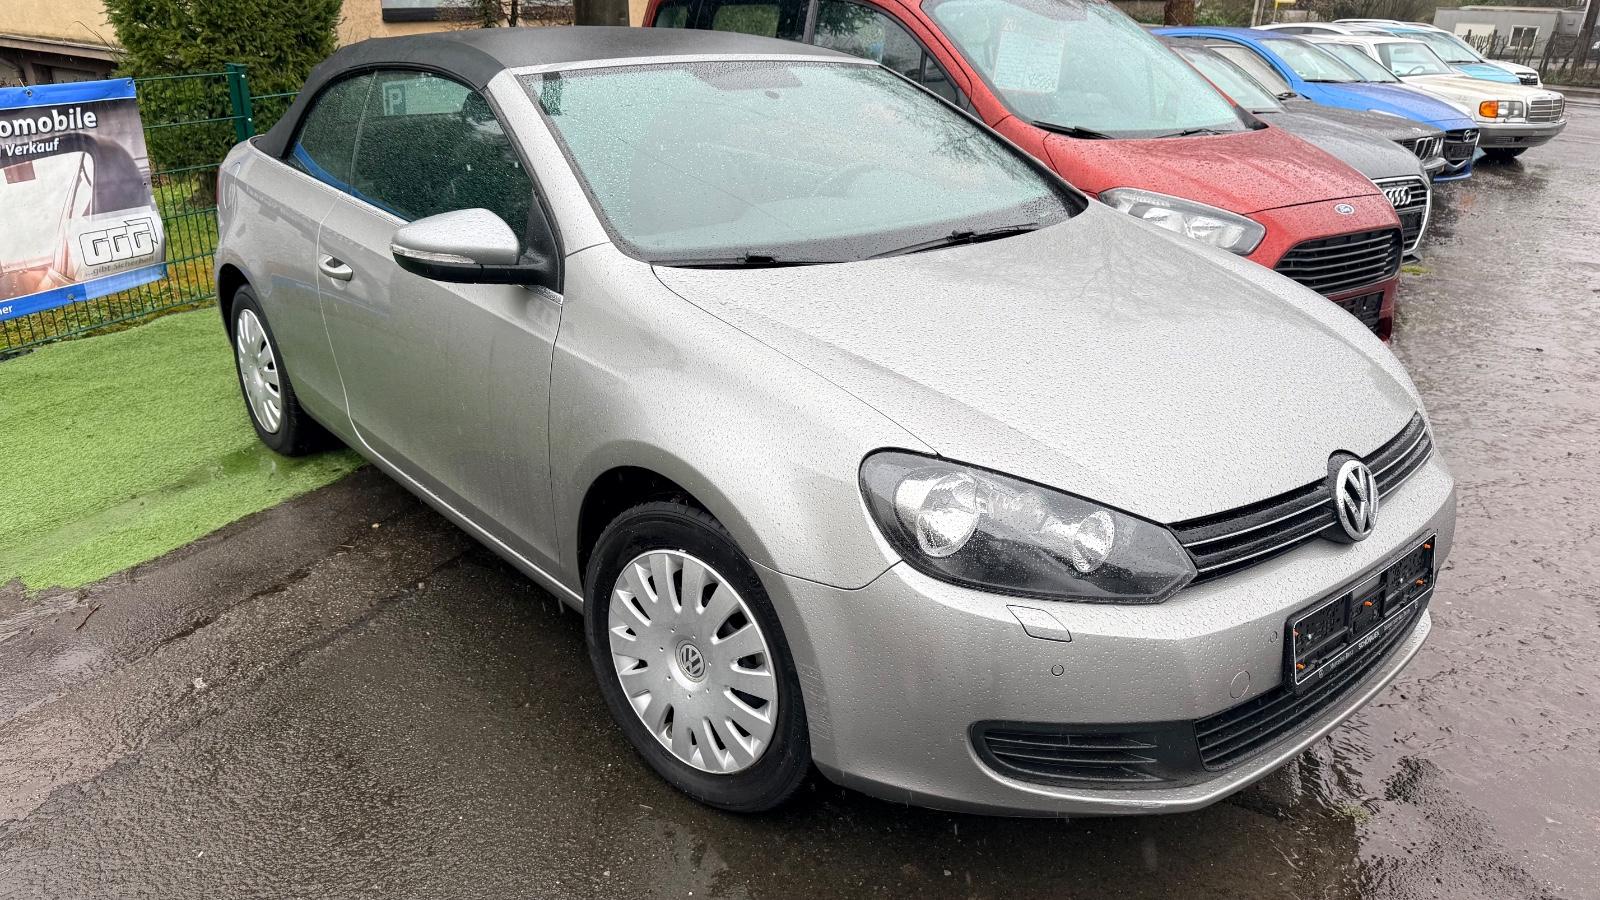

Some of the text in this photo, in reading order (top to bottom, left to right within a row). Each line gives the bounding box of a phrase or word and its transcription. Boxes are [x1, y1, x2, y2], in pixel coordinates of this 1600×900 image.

[388, 88, 402, 116] P
[0, 107, 97, 136] omobile
[5, 138, 60, 157] Verkauf
